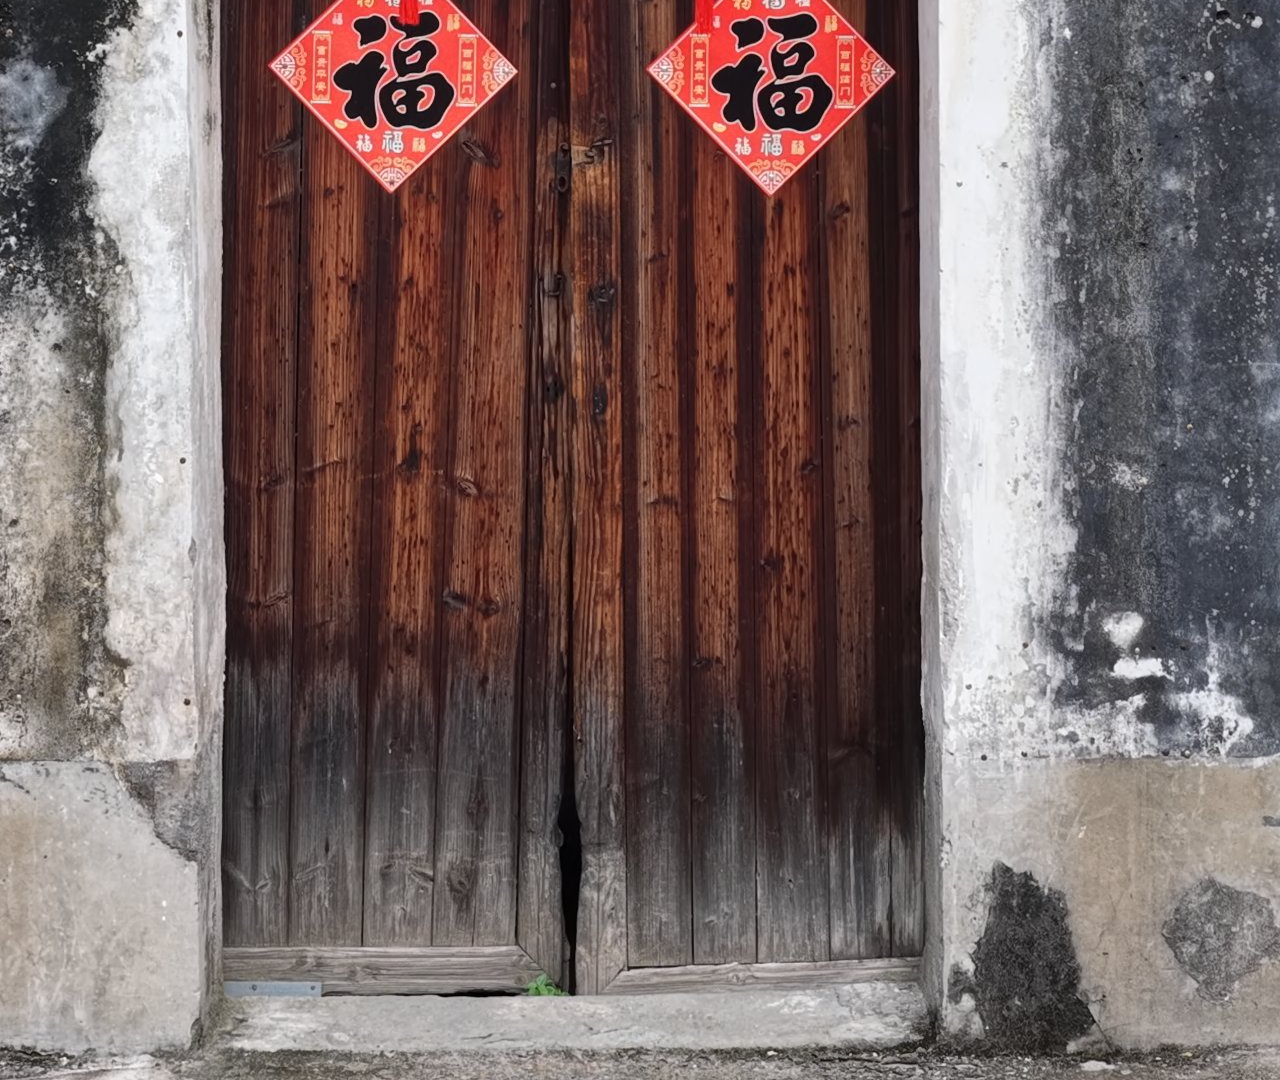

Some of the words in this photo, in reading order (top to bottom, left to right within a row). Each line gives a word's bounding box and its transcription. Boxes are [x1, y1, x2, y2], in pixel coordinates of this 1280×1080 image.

[333, 10, 455, 130] 福
[710, 12, 835, 133] 福
[382, 130, 404, 153] 福
[761, 133, 783, 156] 福
